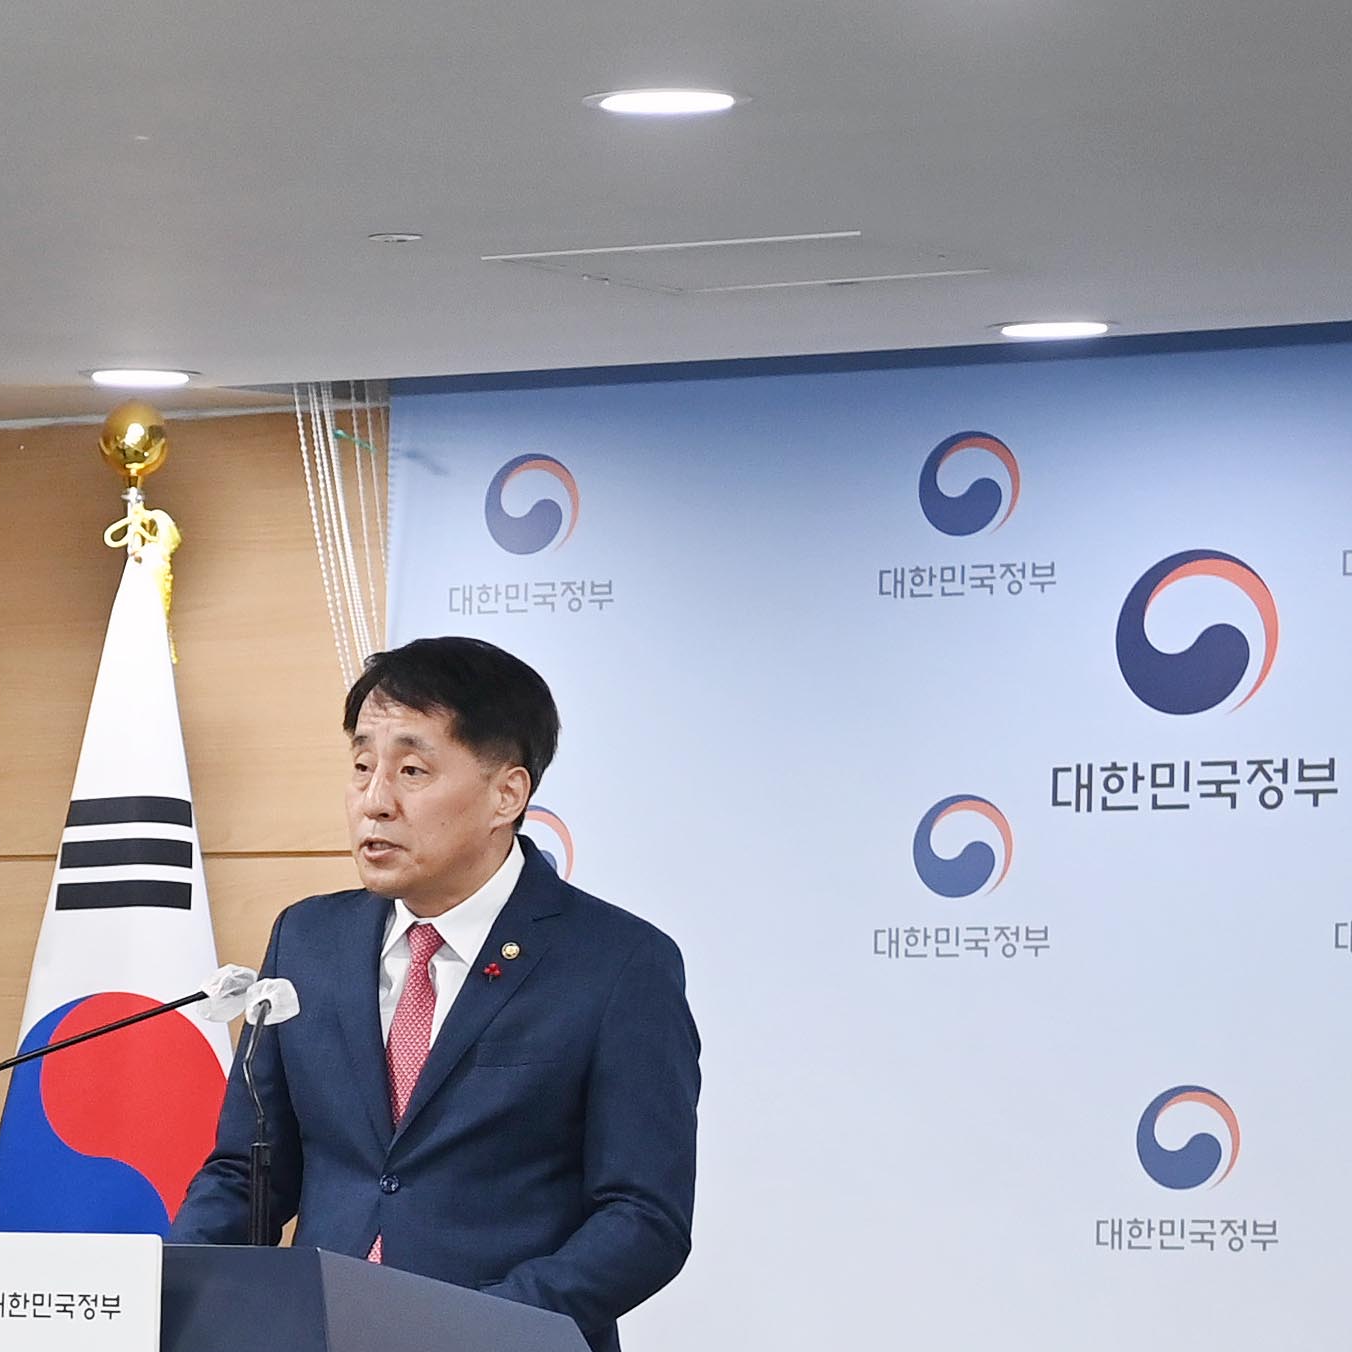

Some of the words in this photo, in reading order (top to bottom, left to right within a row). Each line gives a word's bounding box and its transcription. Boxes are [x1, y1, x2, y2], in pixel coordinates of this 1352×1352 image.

[449, 579, 616, 616] 대한민국정부
[878, 561, 1058, 600] 대한민국정부
[1051, 756, 1340, 815] 대한민국정부
[873, 925, 1052, 960] 대한민국정부
[1095, 1218, 1281, 1254] 대한민국정부
